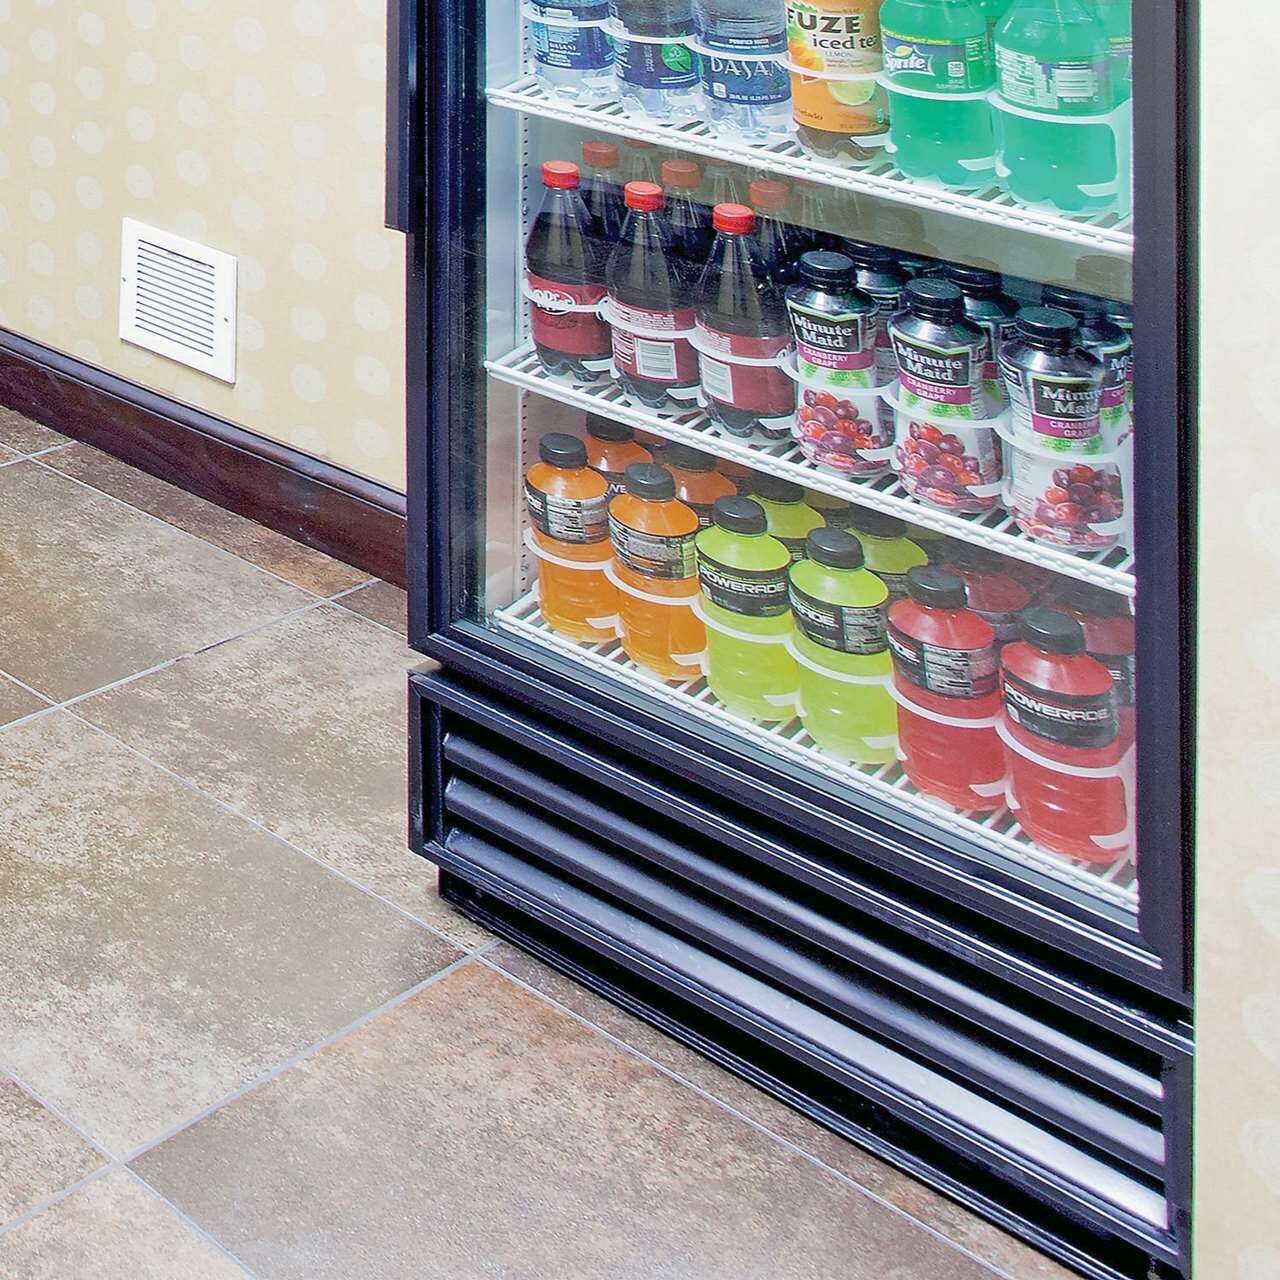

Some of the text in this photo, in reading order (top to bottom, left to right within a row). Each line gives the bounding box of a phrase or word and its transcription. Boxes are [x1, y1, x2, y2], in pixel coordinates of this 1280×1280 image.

[787, 7, 861, 34] FUZE
[813, 34, 855, 50] iced
[824, 50, 853, 58] LEMON
[710, 57, 785, 81] DASAN
[793, 313, 854, 337] Minute
[803, 328, 846, 349] Maid
[803, 347, 848, 362] CRANBERRY
[812, 356, 838, 369] GRAPE
[897, 342, 963, 370] Minute
[908, 360, 954, 382] Maid
[906, 378, 957, 396] CRANBERRY
[917, 388, 945, 402] GRAPE
[699, 567, 787, 594] POWERADE
[1005, 682, 1111, 721] POWERADE
